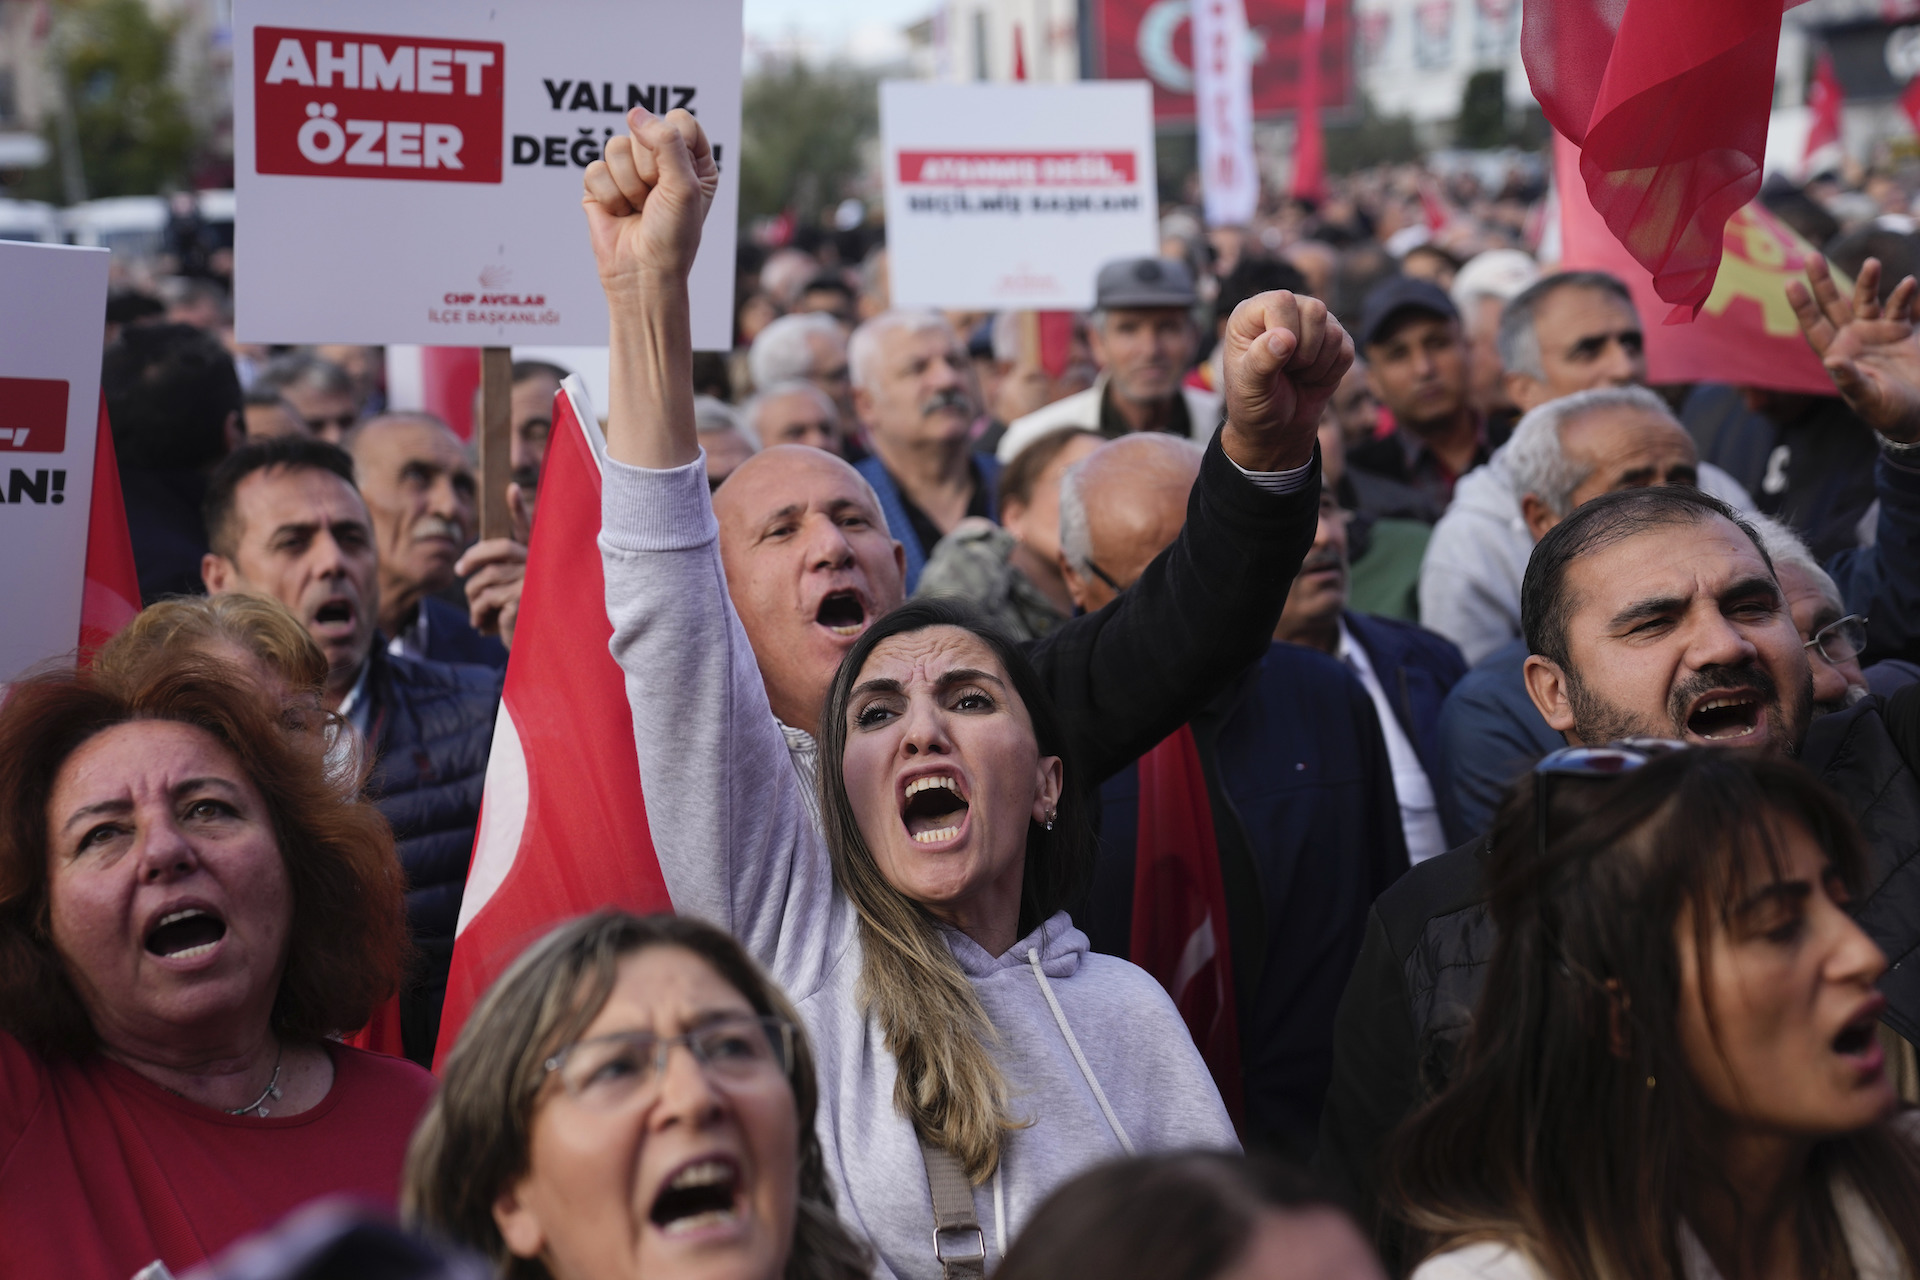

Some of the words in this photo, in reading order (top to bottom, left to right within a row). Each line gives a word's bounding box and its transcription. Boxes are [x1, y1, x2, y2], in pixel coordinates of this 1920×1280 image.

[264, 37, 495, 96] AHMET
[542, 78, 697, 116] YALNIZ
[296, 101, 465, 170] ÖZER
[444, 293, 475, 306] CHP
[480, 294, 545, 307] AVCILAR
